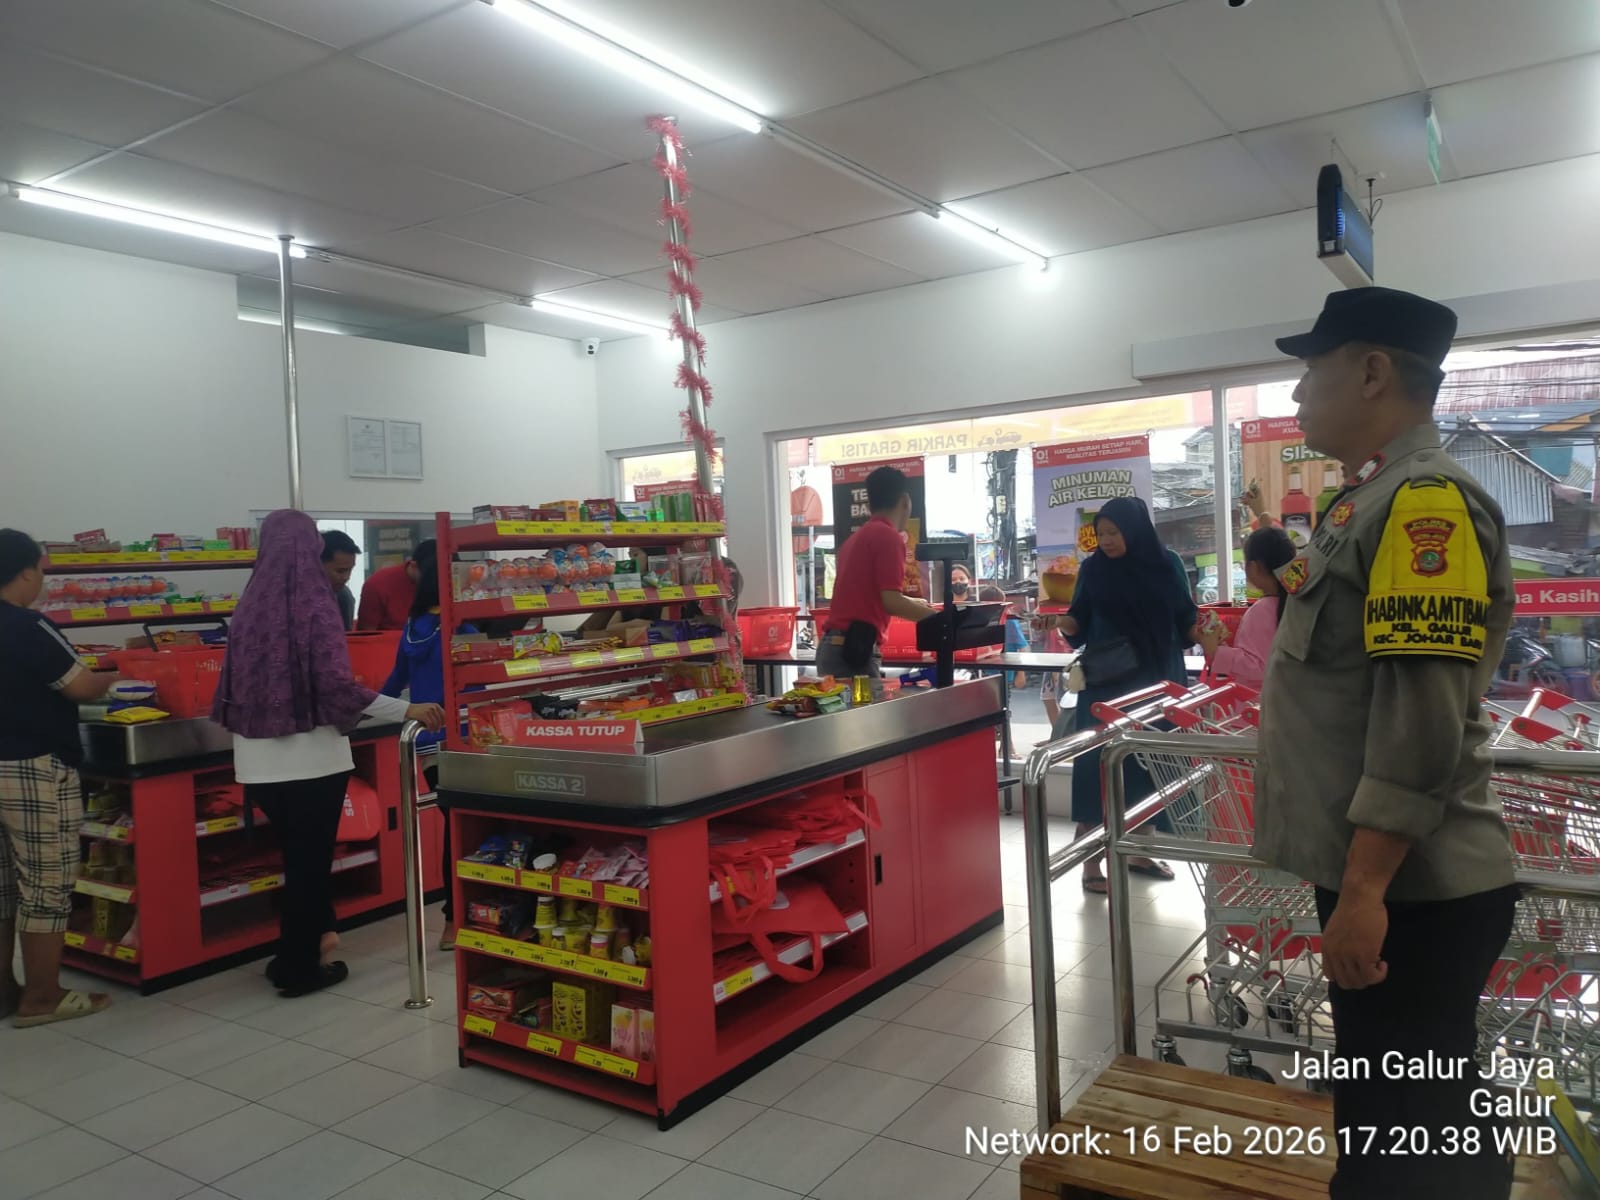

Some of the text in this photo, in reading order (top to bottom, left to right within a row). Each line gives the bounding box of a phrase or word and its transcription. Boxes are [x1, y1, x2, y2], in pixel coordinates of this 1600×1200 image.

[1052, 470, 1131, 490] MINUMAN
[1048, 486, 1137, 507] AIR KELAPA
[1539, 589, 1600, 604] Kasih
[1404, 633, 1455, 645] JOHAR
[526, 725, 625, 737] KASSA TUTUP
[519, 774, 582, 792] KASSA 2
